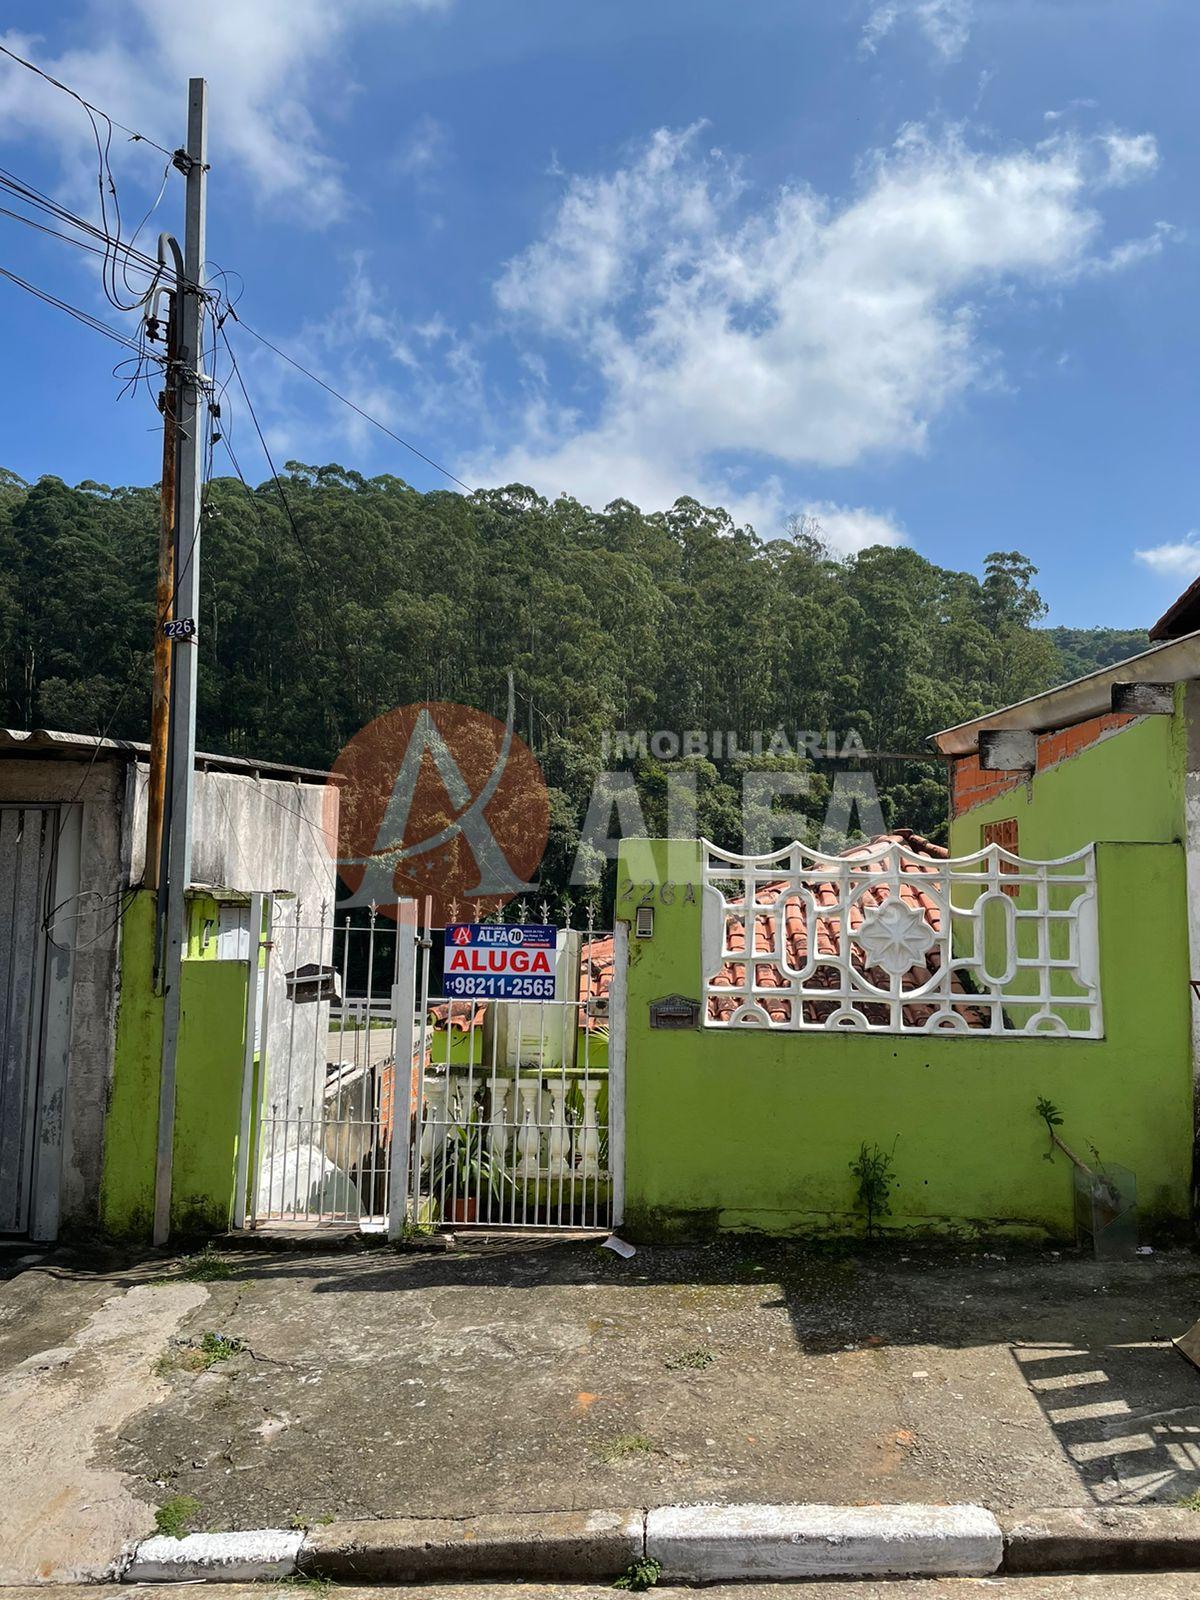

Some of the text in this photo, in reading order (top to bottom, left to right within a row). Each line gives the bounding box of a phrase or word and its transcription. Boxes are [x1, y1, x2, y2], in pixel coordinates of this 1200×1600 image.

[169, 621, 191, 635] 226
[621, 879, 697, 907] 226A
[477, 931, 508, 942] ALFA
[510, 930, 521, 941] 70
[450, 949, 551, 973] ALUGA
